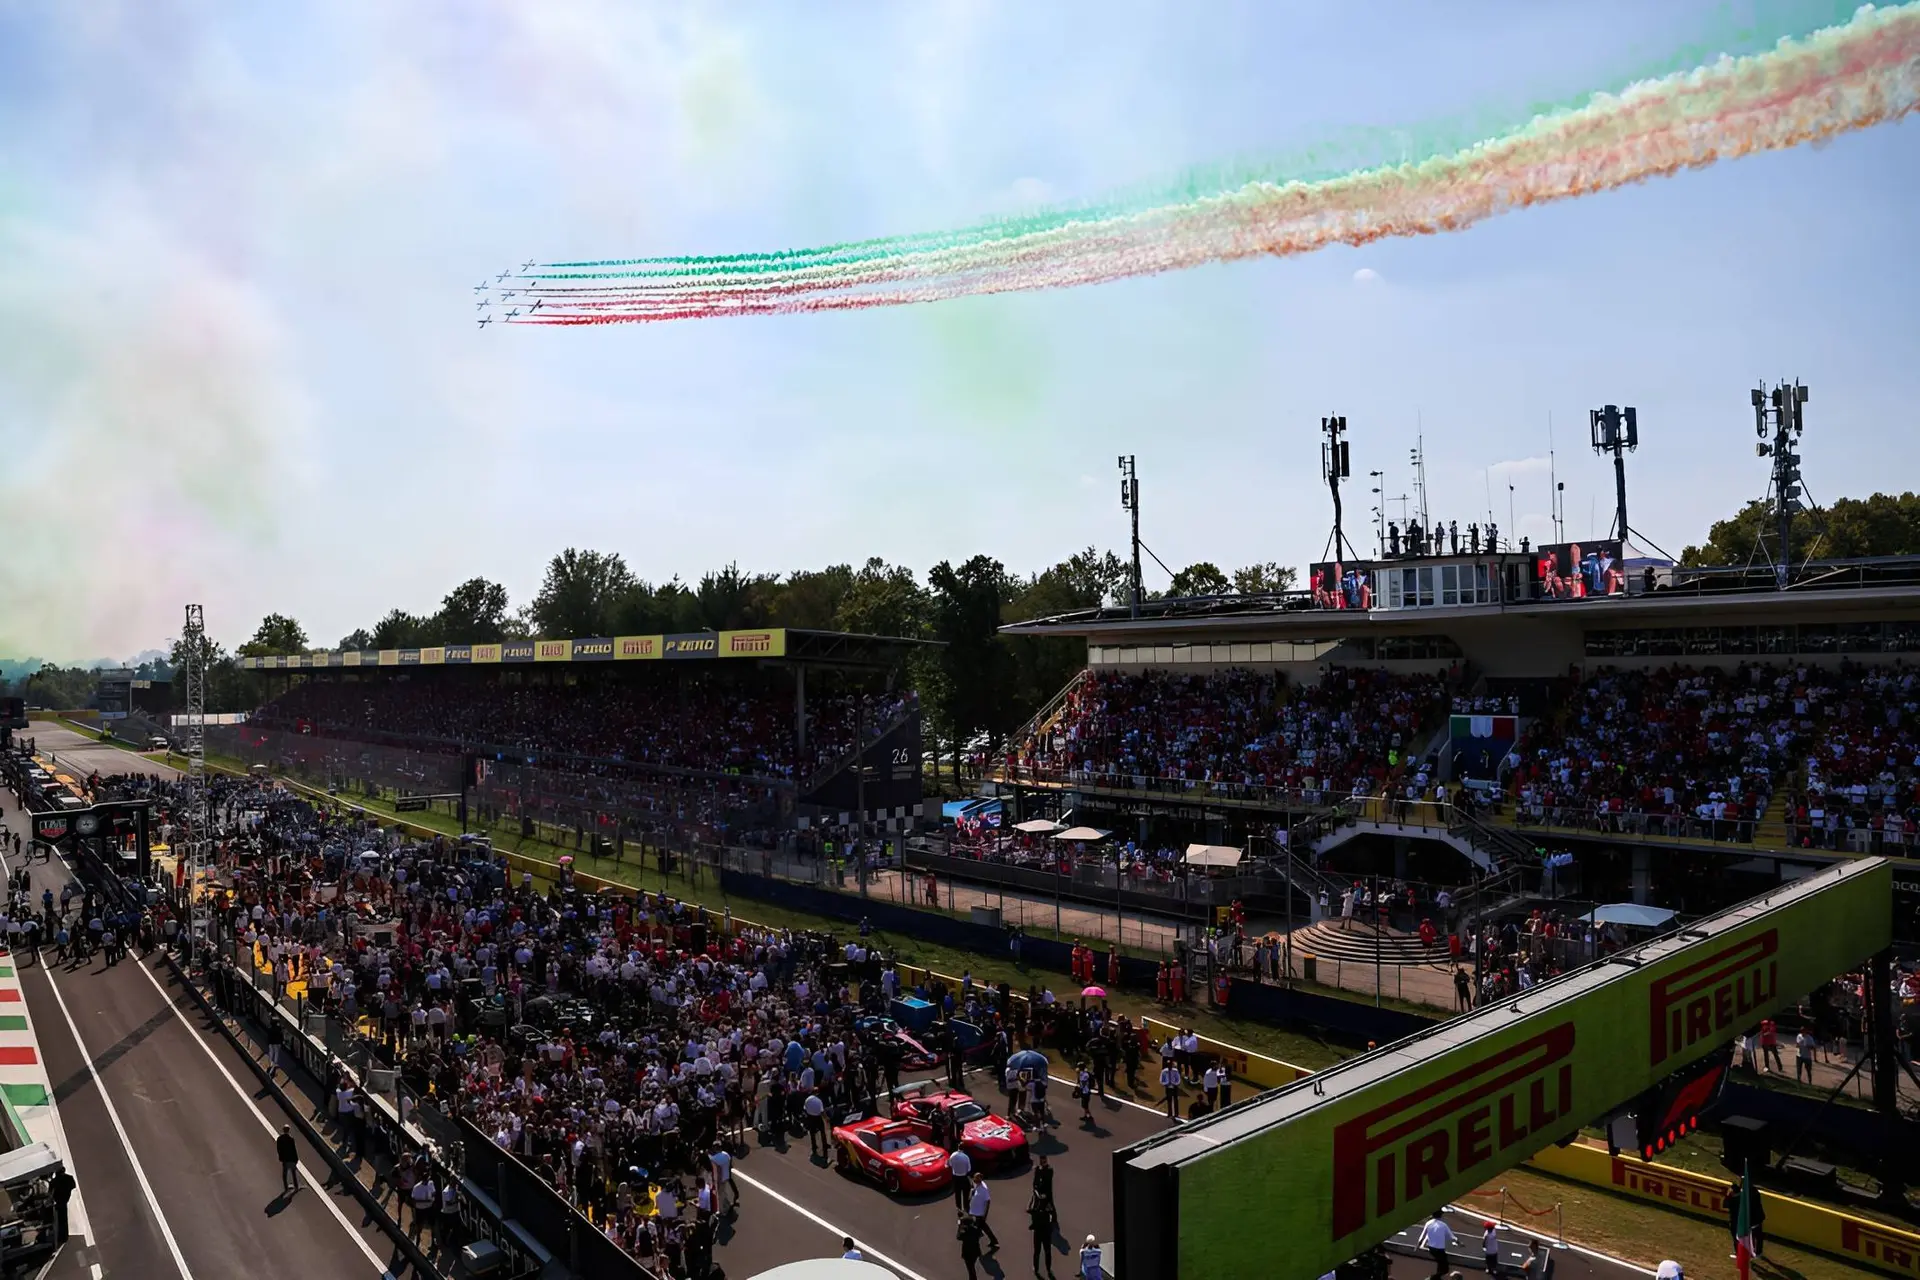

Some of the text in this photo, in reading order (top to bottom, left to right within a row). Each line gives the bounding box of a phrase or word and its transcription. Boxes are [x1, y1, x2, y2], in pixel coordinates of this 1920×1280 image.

[892, 748, 908, 764] 26
[1650, 927, 1778, 1067] PIRELLI
[1332, 1020, 1576, 1243] PIRELLI
[1612, 1157, 1731, 1215] PIRELL
